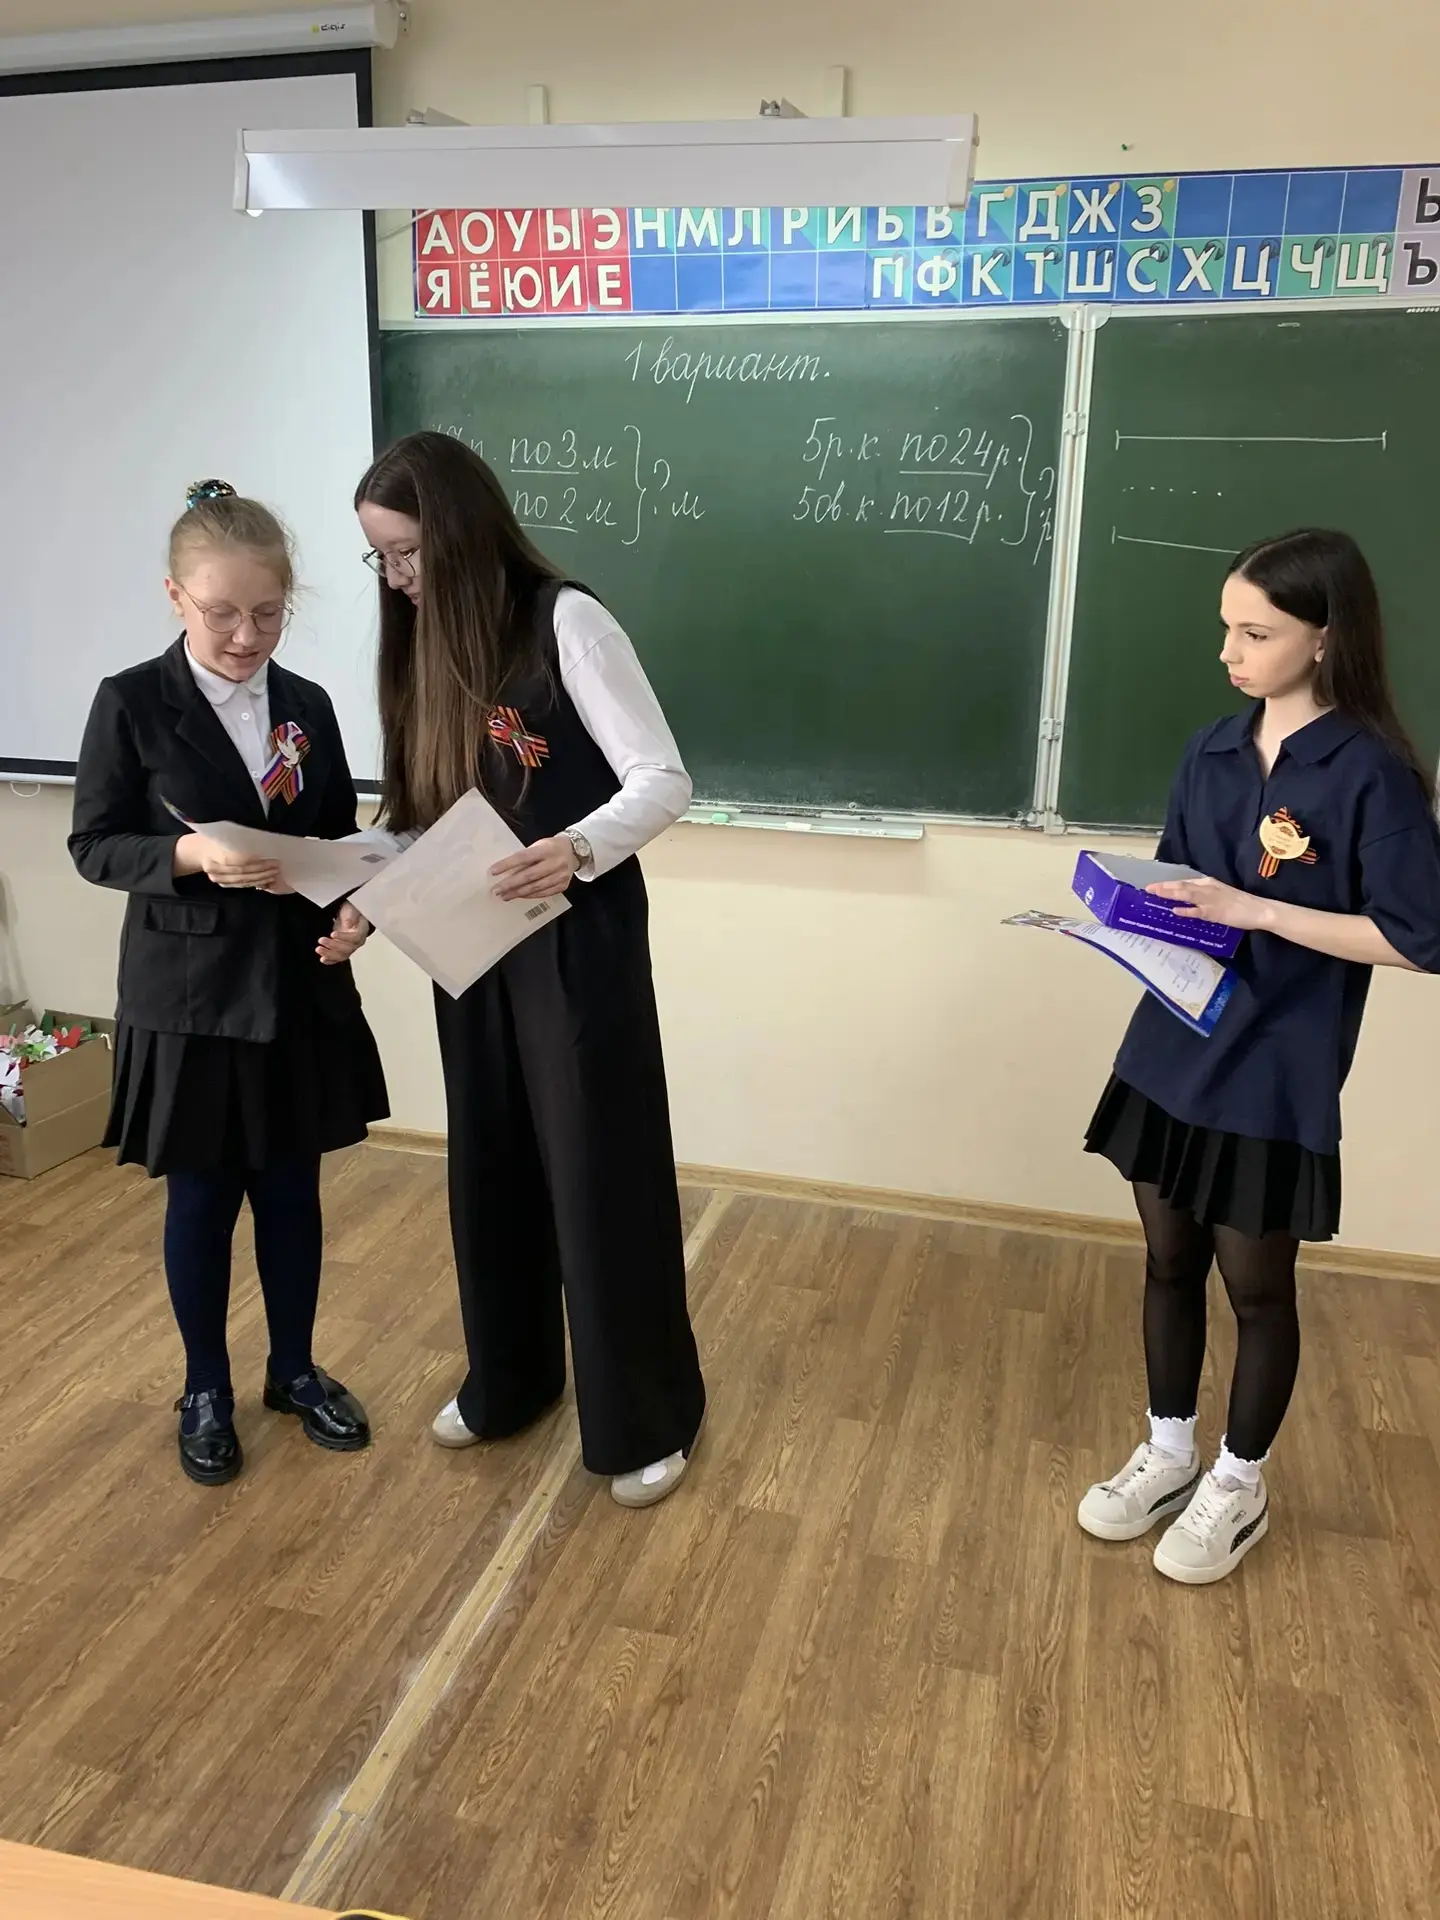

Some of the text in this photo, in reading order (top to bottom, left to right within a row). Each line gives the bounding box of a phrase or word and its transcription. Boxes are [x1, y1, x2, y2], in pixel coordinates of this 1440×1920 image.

[421, 214, 455, 255] А
[460, 211, 495, 255] О
[503, 210, 533, 252] У
[592, 208, 621, 251] Э
[634, 208, 666, 249] Н
[676, 208, 719, 248] М
[827, 207, 862, 244] И
[977, 193, 1006, 237] Г
[1019, 190, 1062, 242] Д
[1069, 189, 1117, 234] Ж
[1131, 186, 1164, 233] З
[426, 242, 1438, 310] Я Ё Ю И Е П Ф К Т Ш С Х Ц Ч Щ Ъ
[624, 335, 832, 404] 1 вариант.
